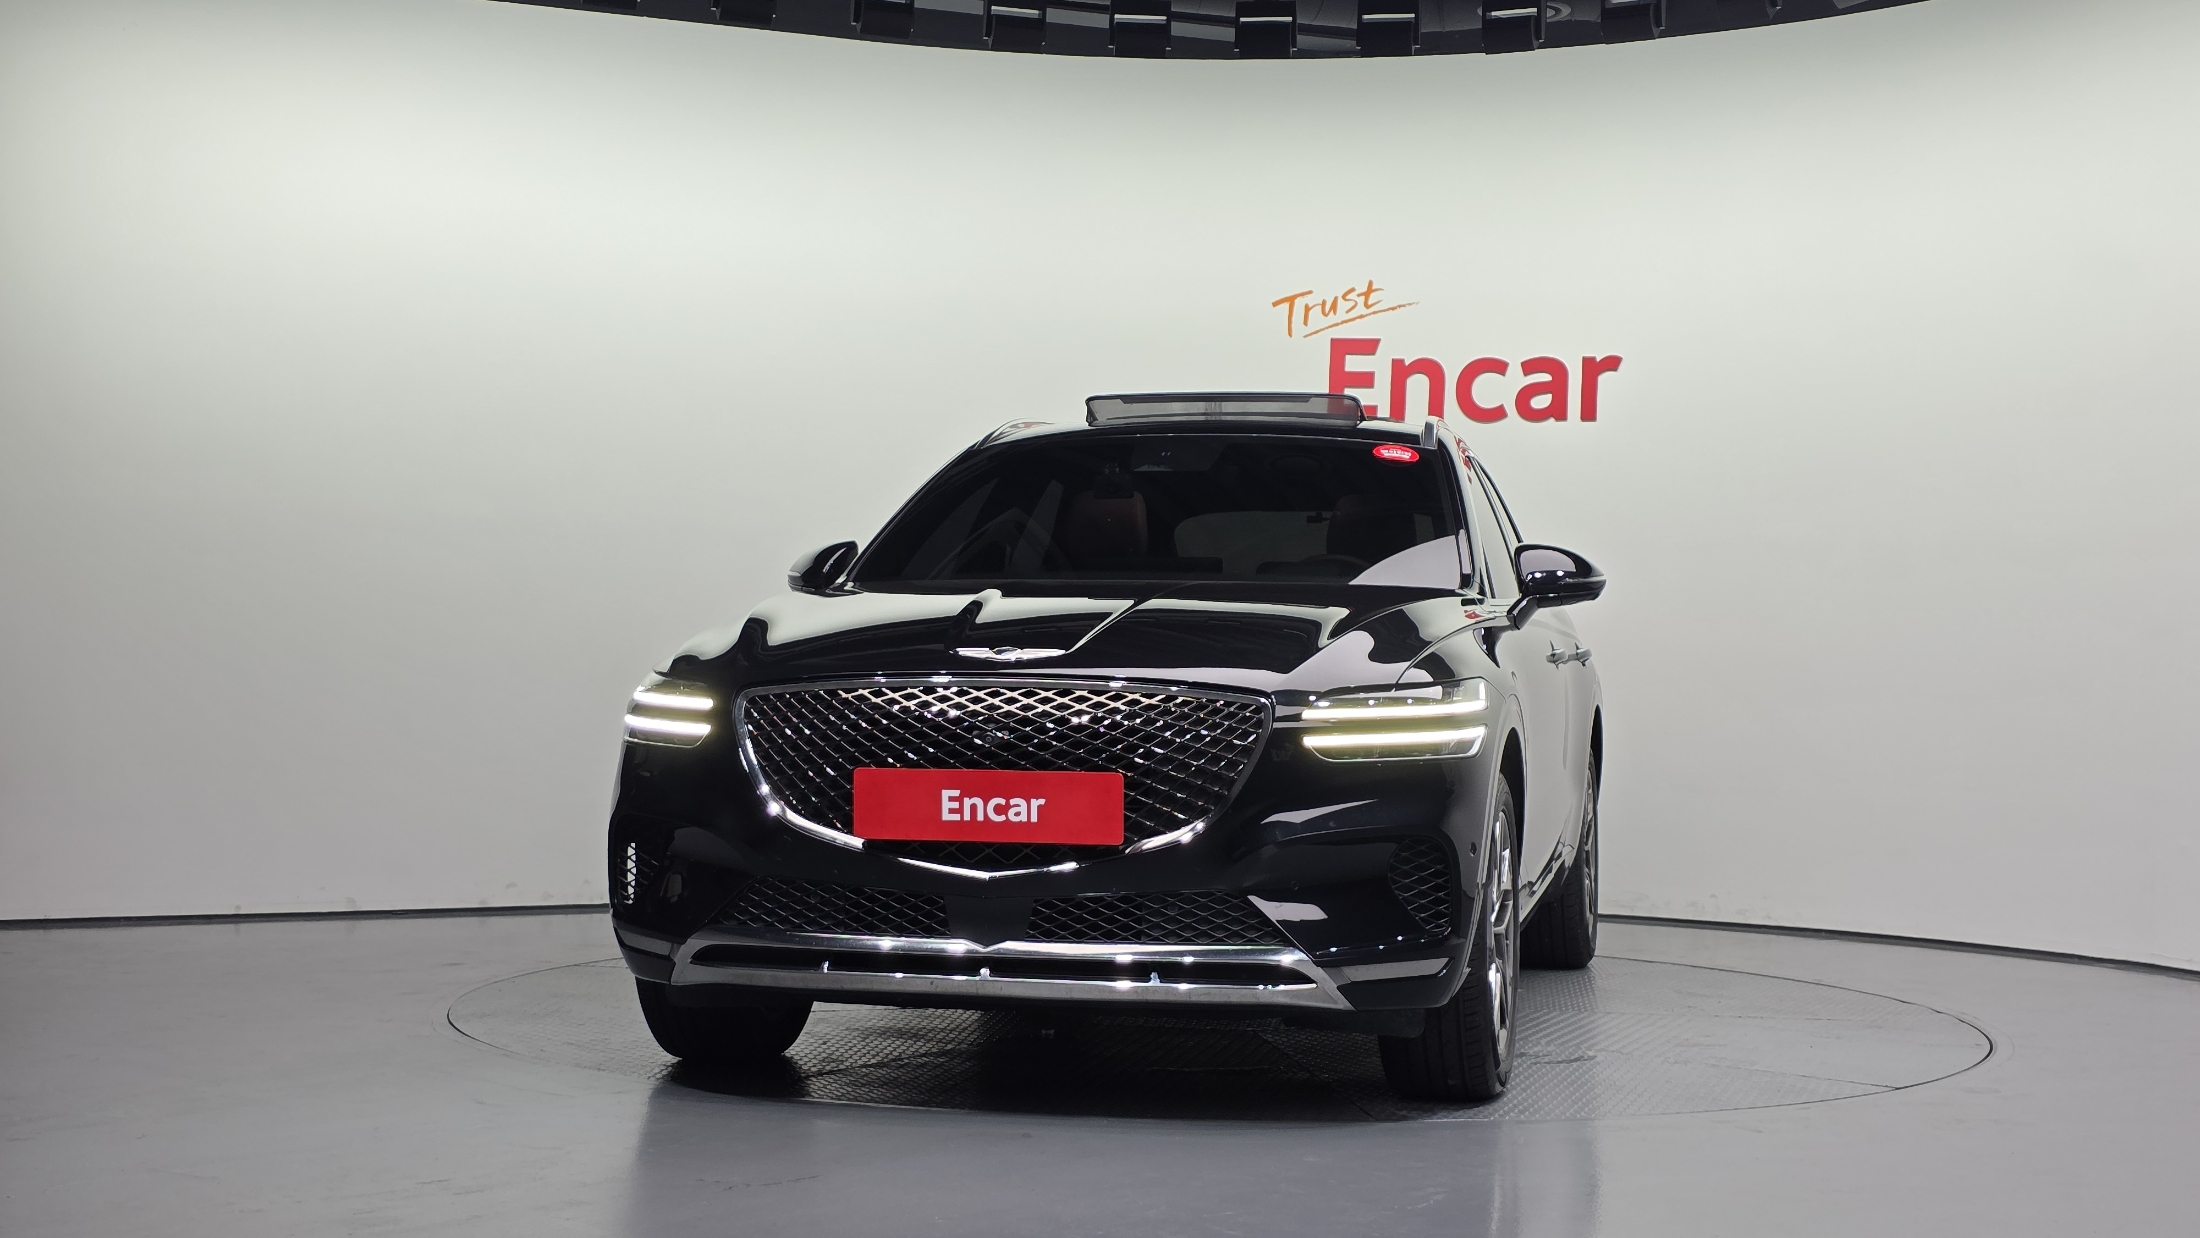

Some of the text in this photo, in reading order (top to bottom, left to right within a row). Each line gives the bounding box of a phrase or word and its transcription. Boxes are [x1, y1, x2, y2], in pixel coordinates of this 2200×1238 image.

[1271, 279, 1385, 338] Trust
[1328, 337, 1624, 423] Encar
[941, 789, 1046, 823] Encar
